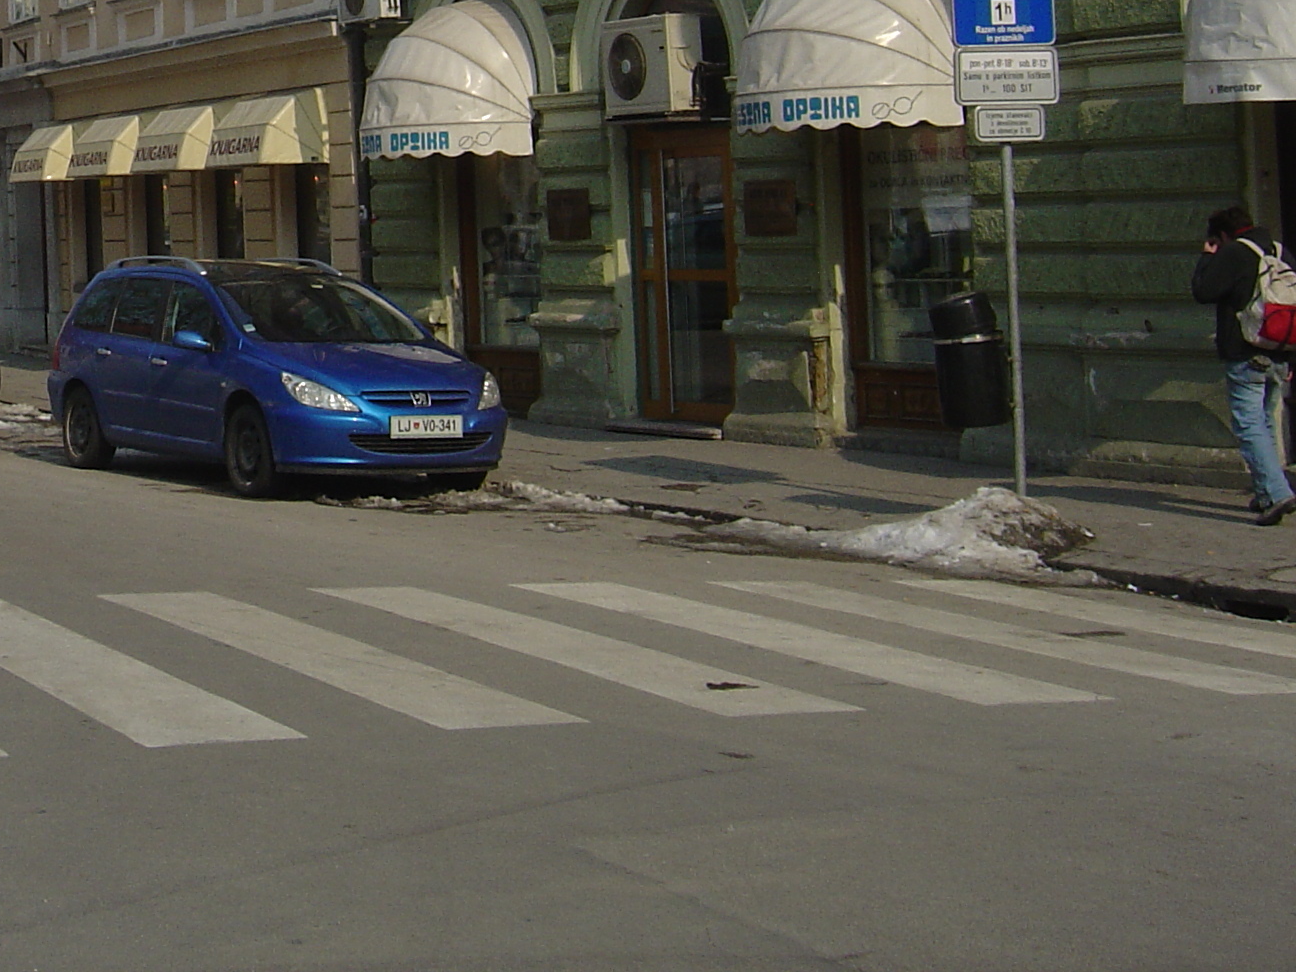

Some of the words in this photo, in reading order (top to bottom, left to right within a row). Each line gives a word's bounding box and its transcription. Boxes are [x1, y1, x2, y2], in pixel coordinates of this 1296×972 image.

[1216, 82, 1262, 95] Mercator
[782, 95, 859, 122] OPTIKA
[390, 131, 450, 152] OPTIKA
[398, 419, 411, 433] LJ
